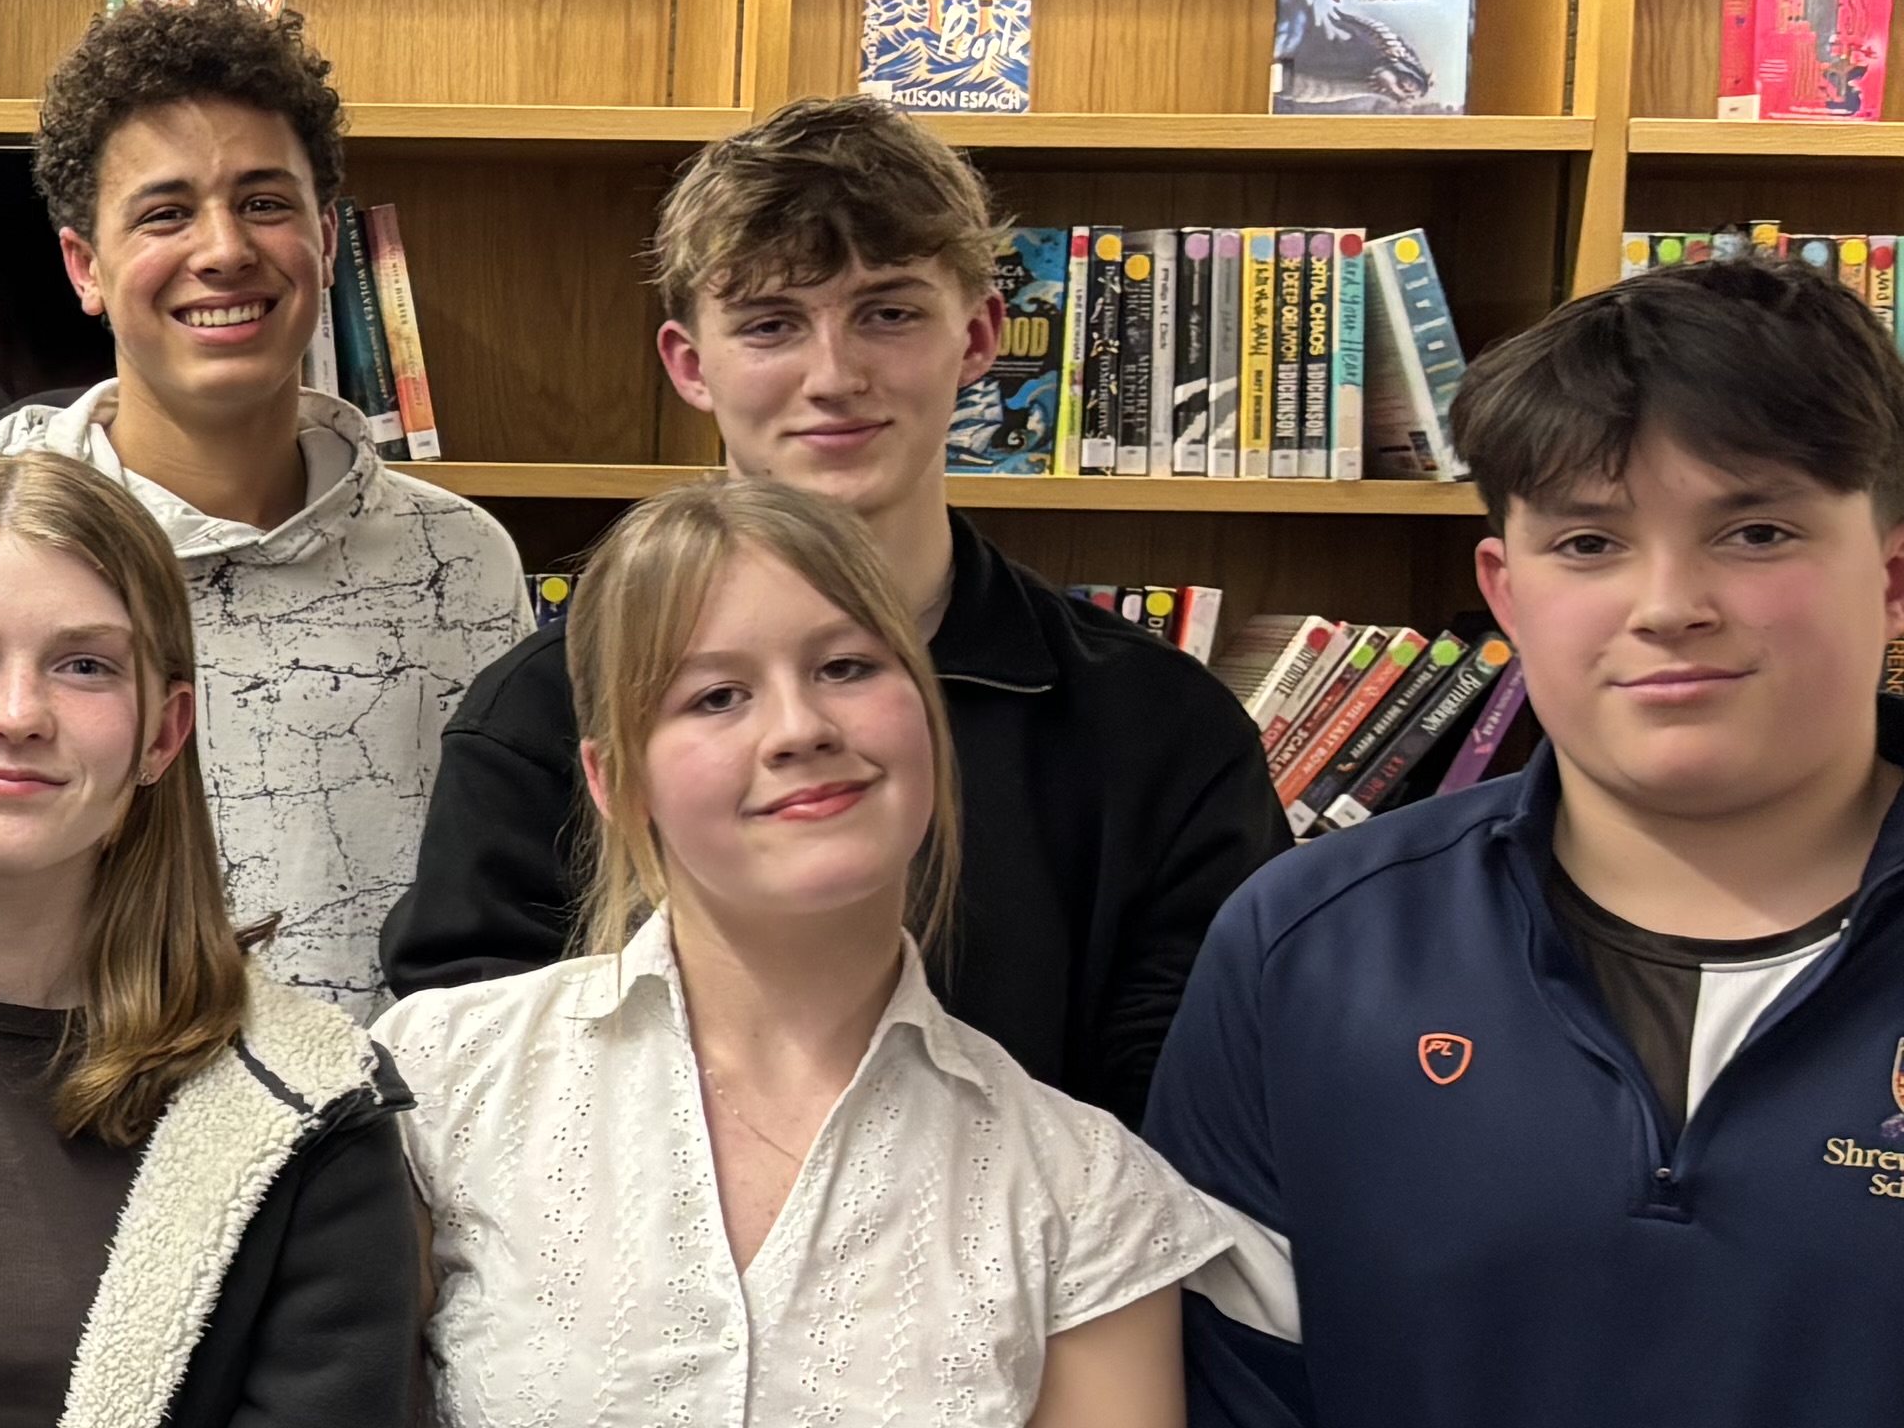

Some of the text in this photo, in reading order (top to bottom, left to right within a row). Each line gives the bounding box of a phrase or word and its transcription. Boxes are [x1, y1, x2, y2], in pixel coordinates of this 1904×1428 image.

[938, 5, 1027, 63] People
[891, 91, 1021, 110] ALISON ESPACH
[347, 229, 364, 267] WERE
[355, 268, 376, 322] WOLVES
[1160, 267, 1169, 350] Philip Dick
[1276, 271, 1300, 437] DEEP OBLIVION DICKINSON
[1305, 302, 1327, 437] CHAOS DICKINSON
[1097, 353, 1110, 430] TOMORROW
[1123, 365, 1136, 424] REPORT
[1137, 352, 1150, 434] MINORITY
[1299, 717, 1351, 776] LAST BOW
